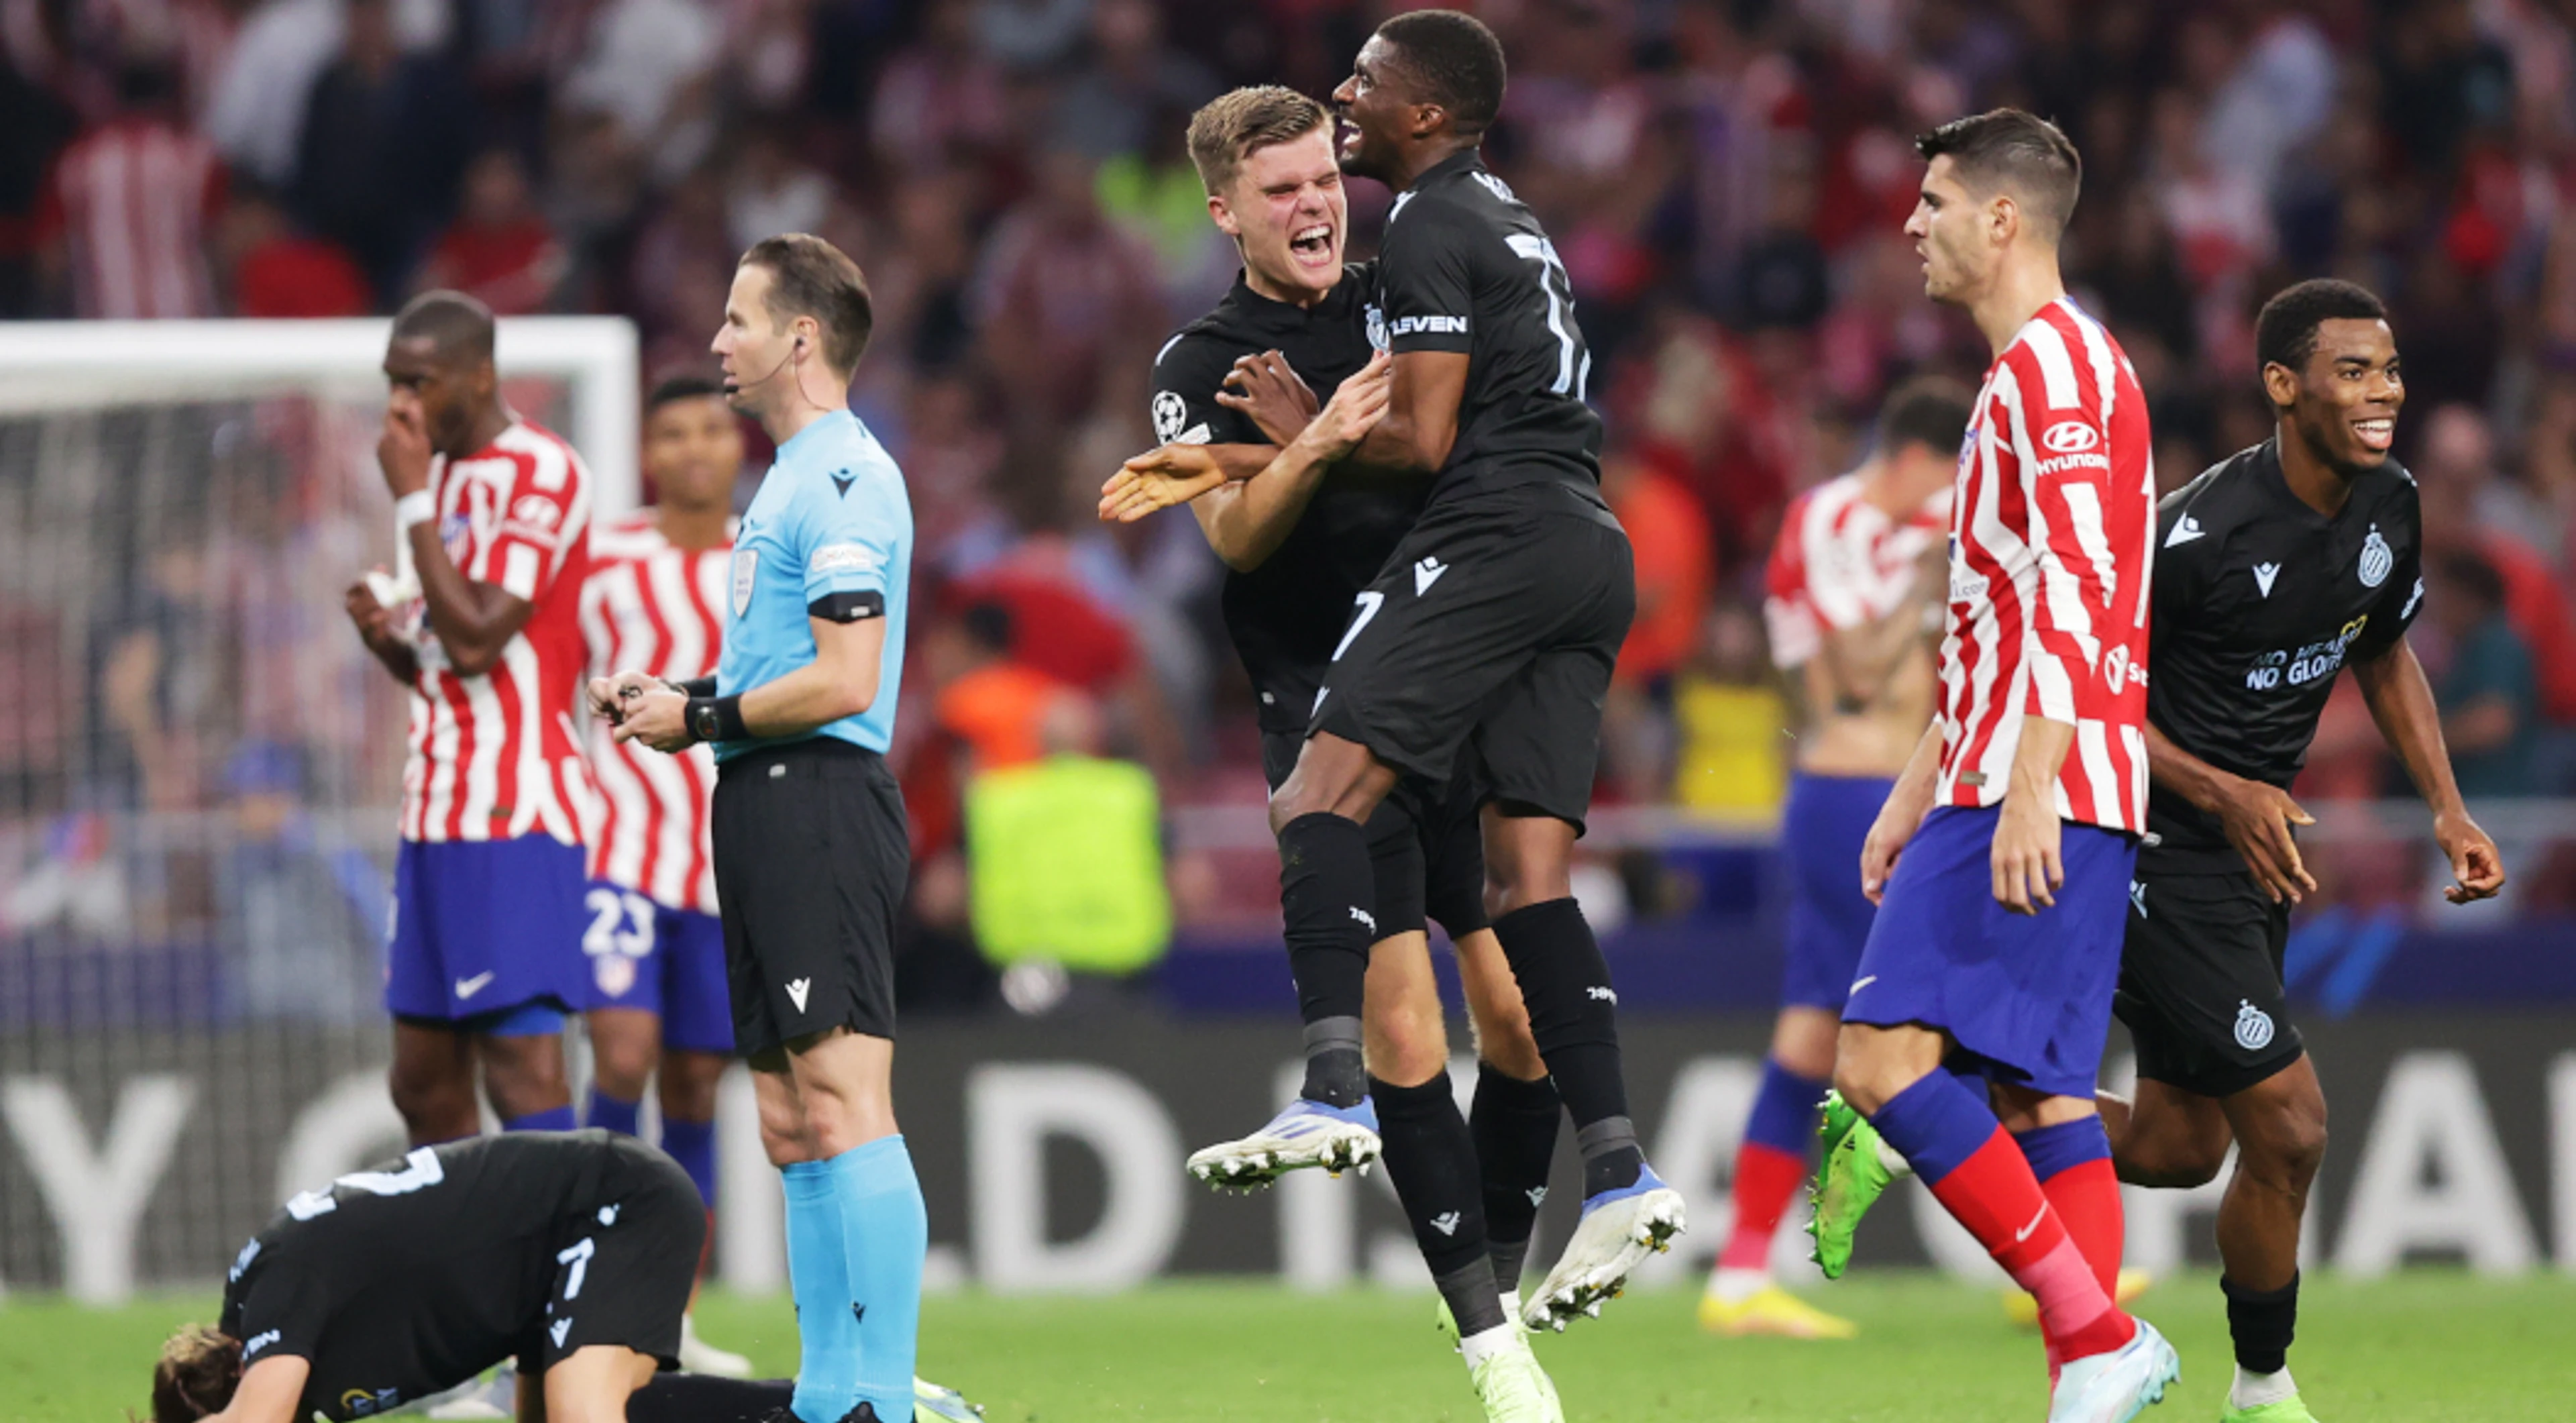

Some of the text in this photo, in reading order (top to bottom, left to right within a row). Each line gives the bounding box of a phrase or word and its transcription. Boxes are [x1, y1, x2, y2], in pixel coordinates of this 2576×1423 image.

[1331, 590, 1385, 662] 7
[2247, 667, 2280, 690] NO
[581, 888, 657, 958] 23
